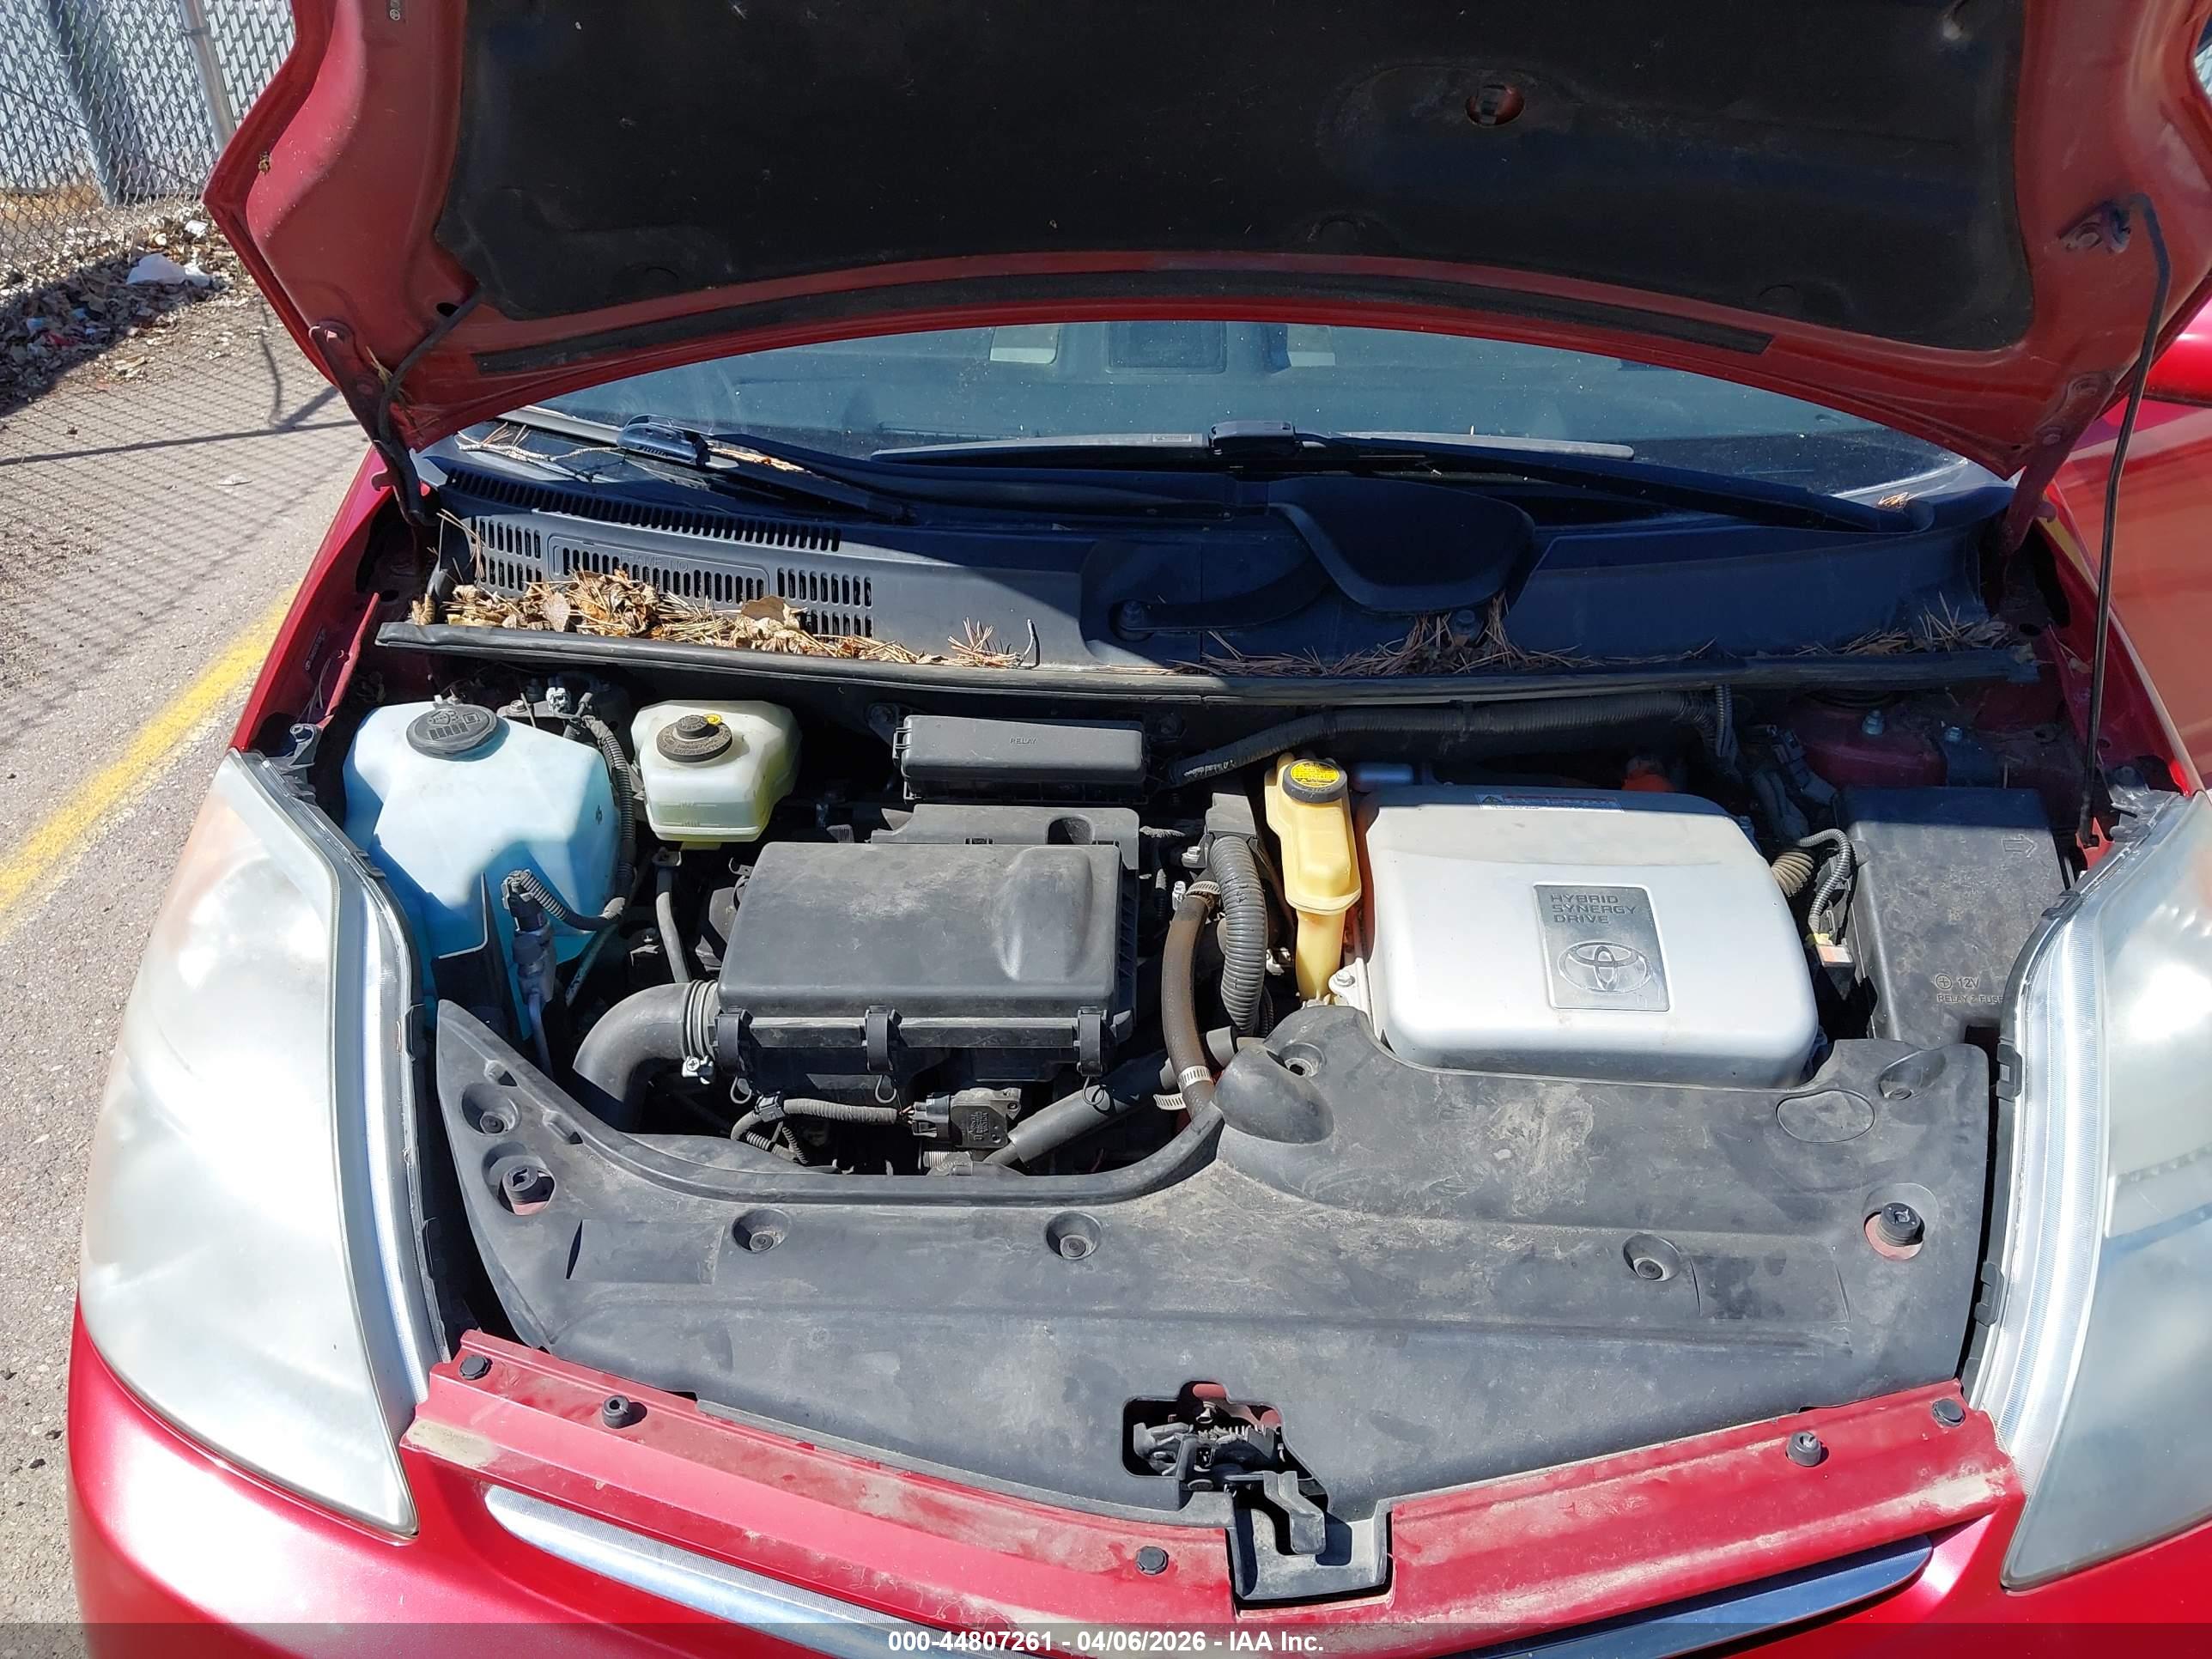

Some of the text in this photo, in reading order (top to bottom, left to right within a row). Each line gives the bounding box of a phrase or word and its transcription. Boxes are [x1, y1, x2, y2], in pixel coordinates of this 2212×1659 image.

[1551, 894, 1619, 904] HYBRID
[1552, 903, 1637, 915] SYNERGY
[1554, 914, 1609, 924] DRIVE
[1957, 977, 1979, 989] 12V
[1937, 994, 1968, 1004] RELAY
